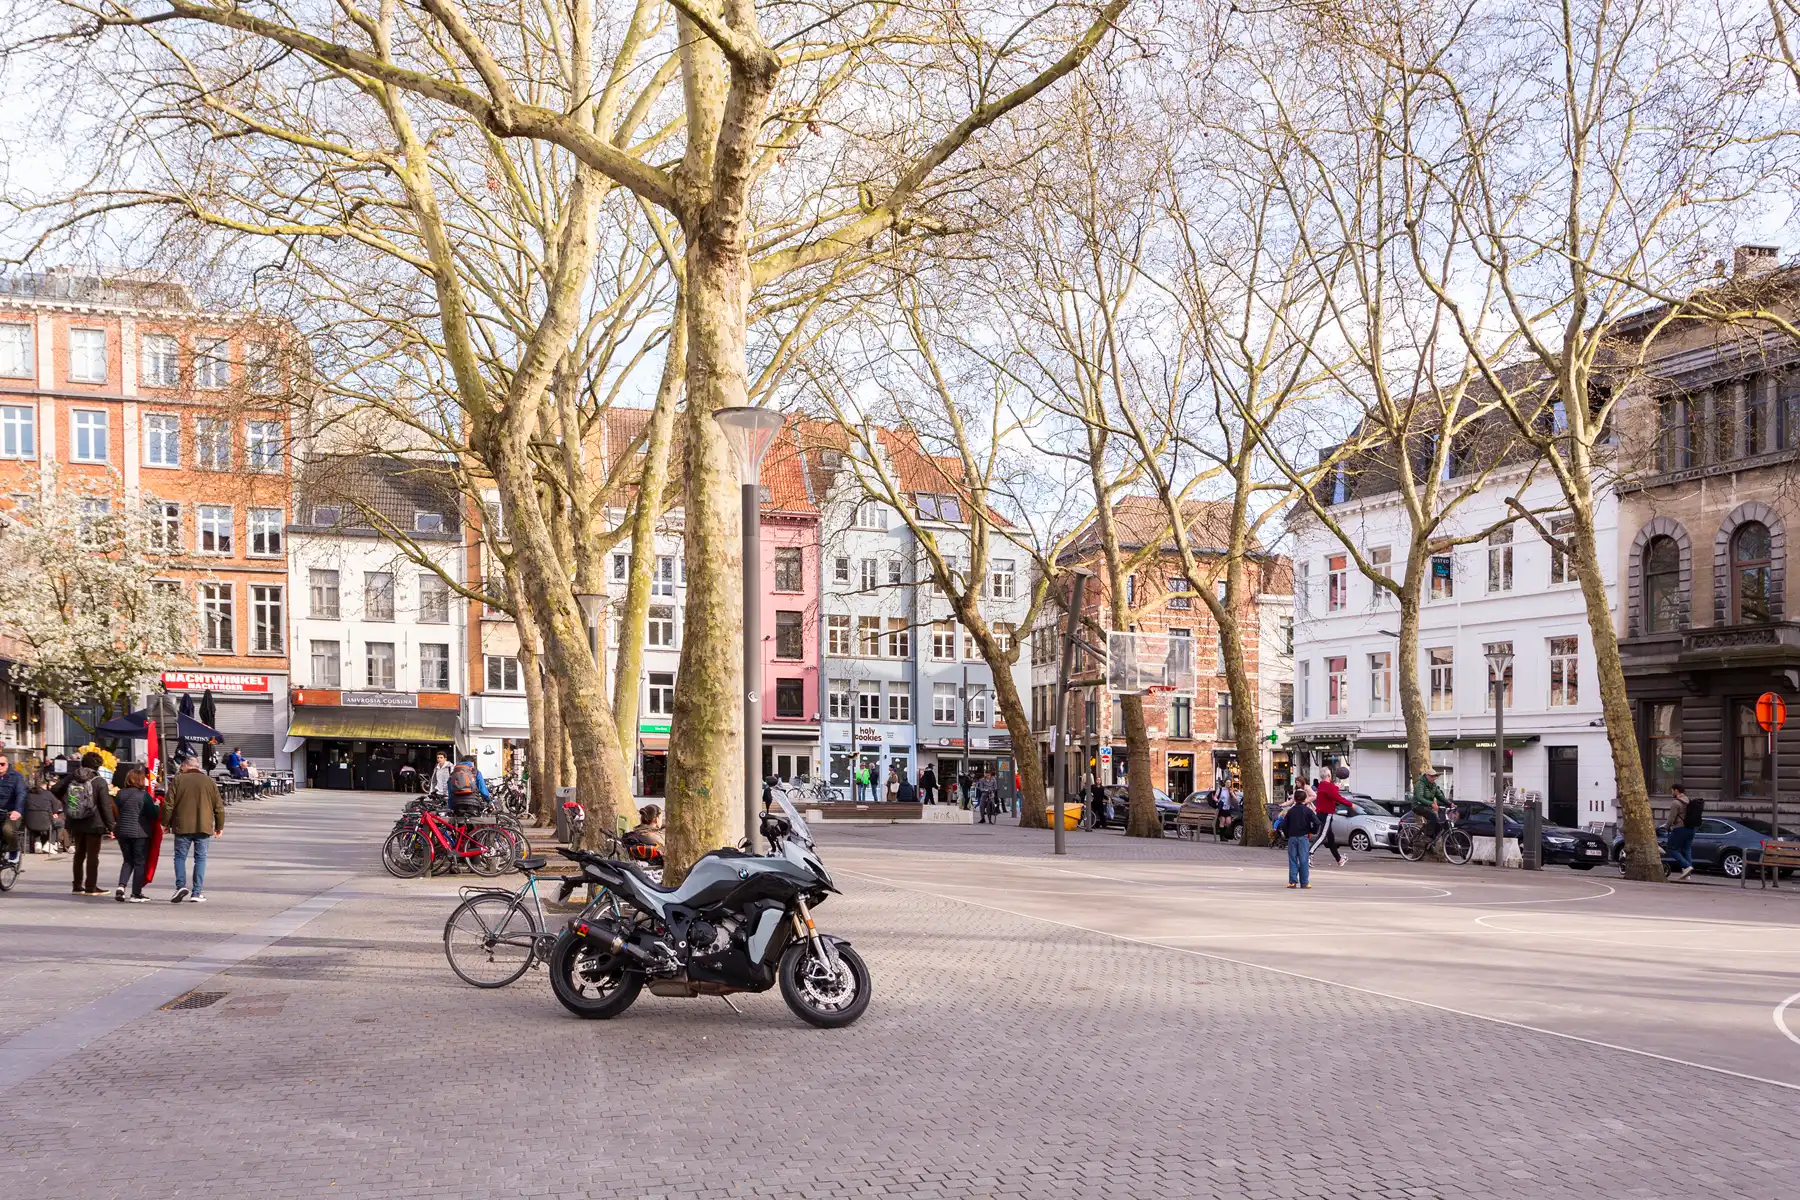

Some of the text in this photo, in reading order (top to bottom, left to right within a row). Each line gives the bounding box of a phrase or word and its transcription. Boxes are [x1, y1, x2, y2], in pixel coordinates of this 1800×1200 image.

[165, 672, 265, 686] NACHTWINKEL
[859, 726, 876, 736] holy
[854, 733, 882, 742] cookies
